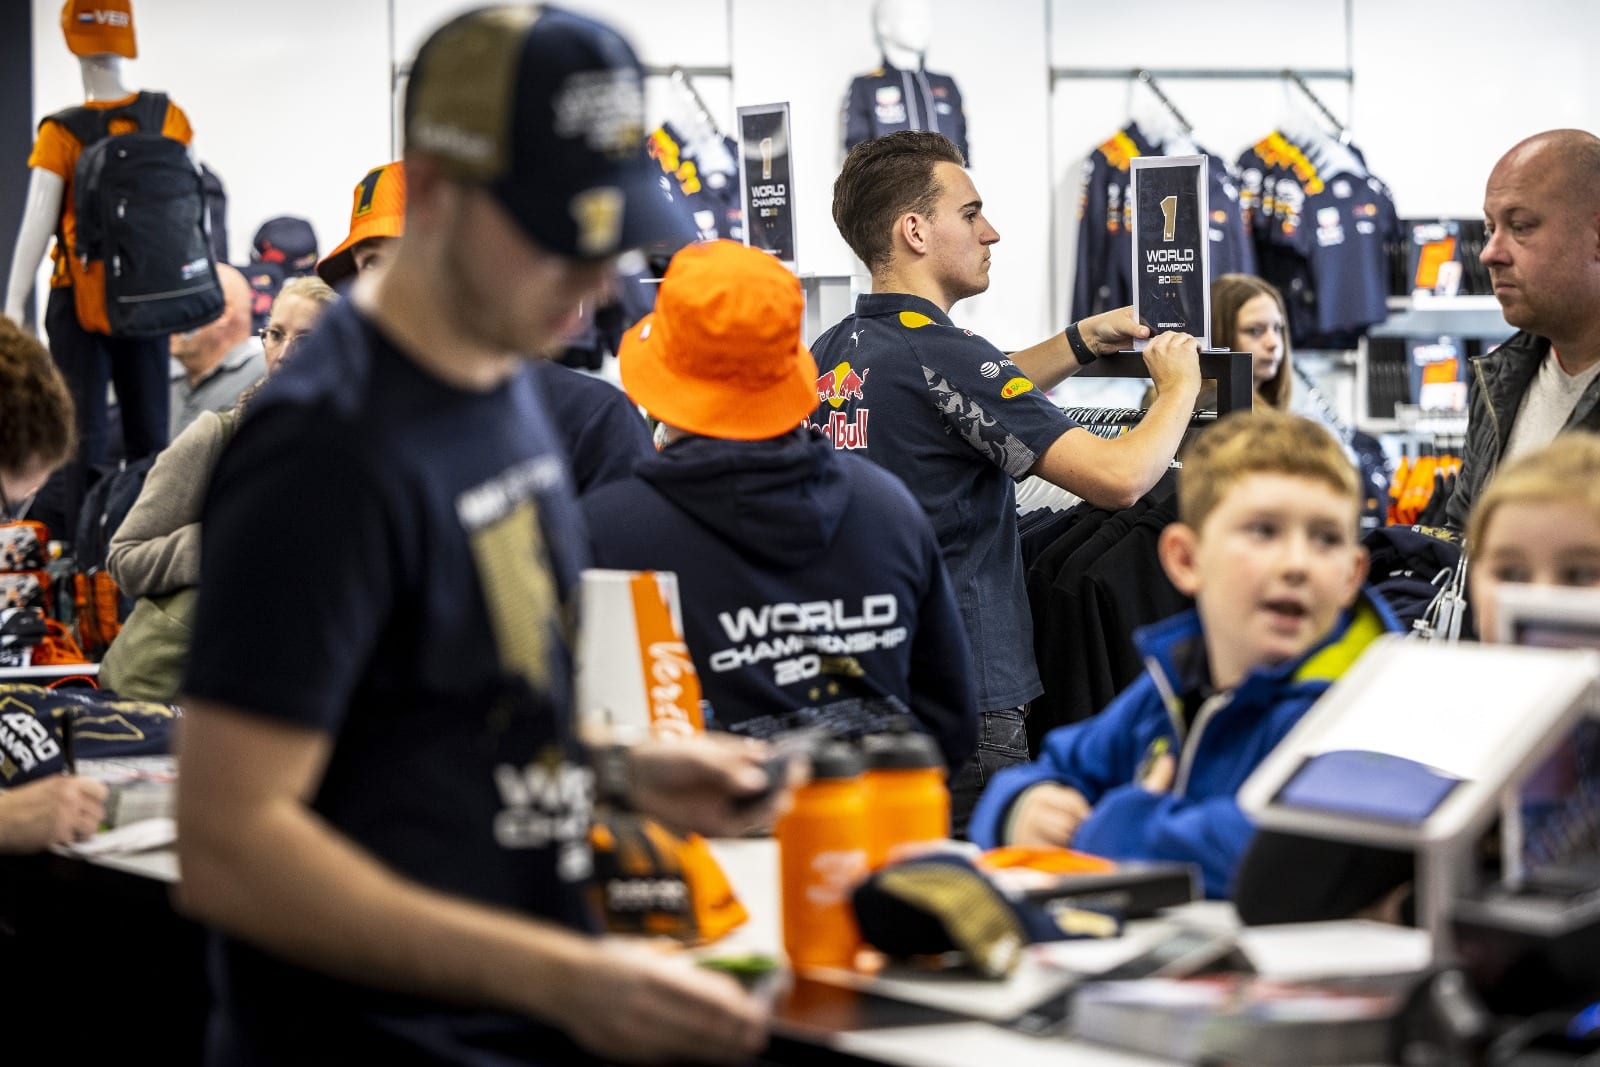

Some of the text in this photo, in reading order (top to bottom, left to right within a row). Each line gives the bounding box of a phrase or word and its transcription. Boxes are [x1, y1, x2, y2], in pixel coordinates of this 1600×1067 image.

[751, 184, 786, 198] WORLD
[751, 197, 786, 208] CHAMPION
[1160, 195, 1178, 242] 1
[1146, 248, 1194, 263] WORLD
[1146, 263, 1194, 274] CHAMPION
[1158, 275, 1183, 285] 2022
[835, 408, 869, 450] Bull
[718, 593, 898, 642] WORLD
